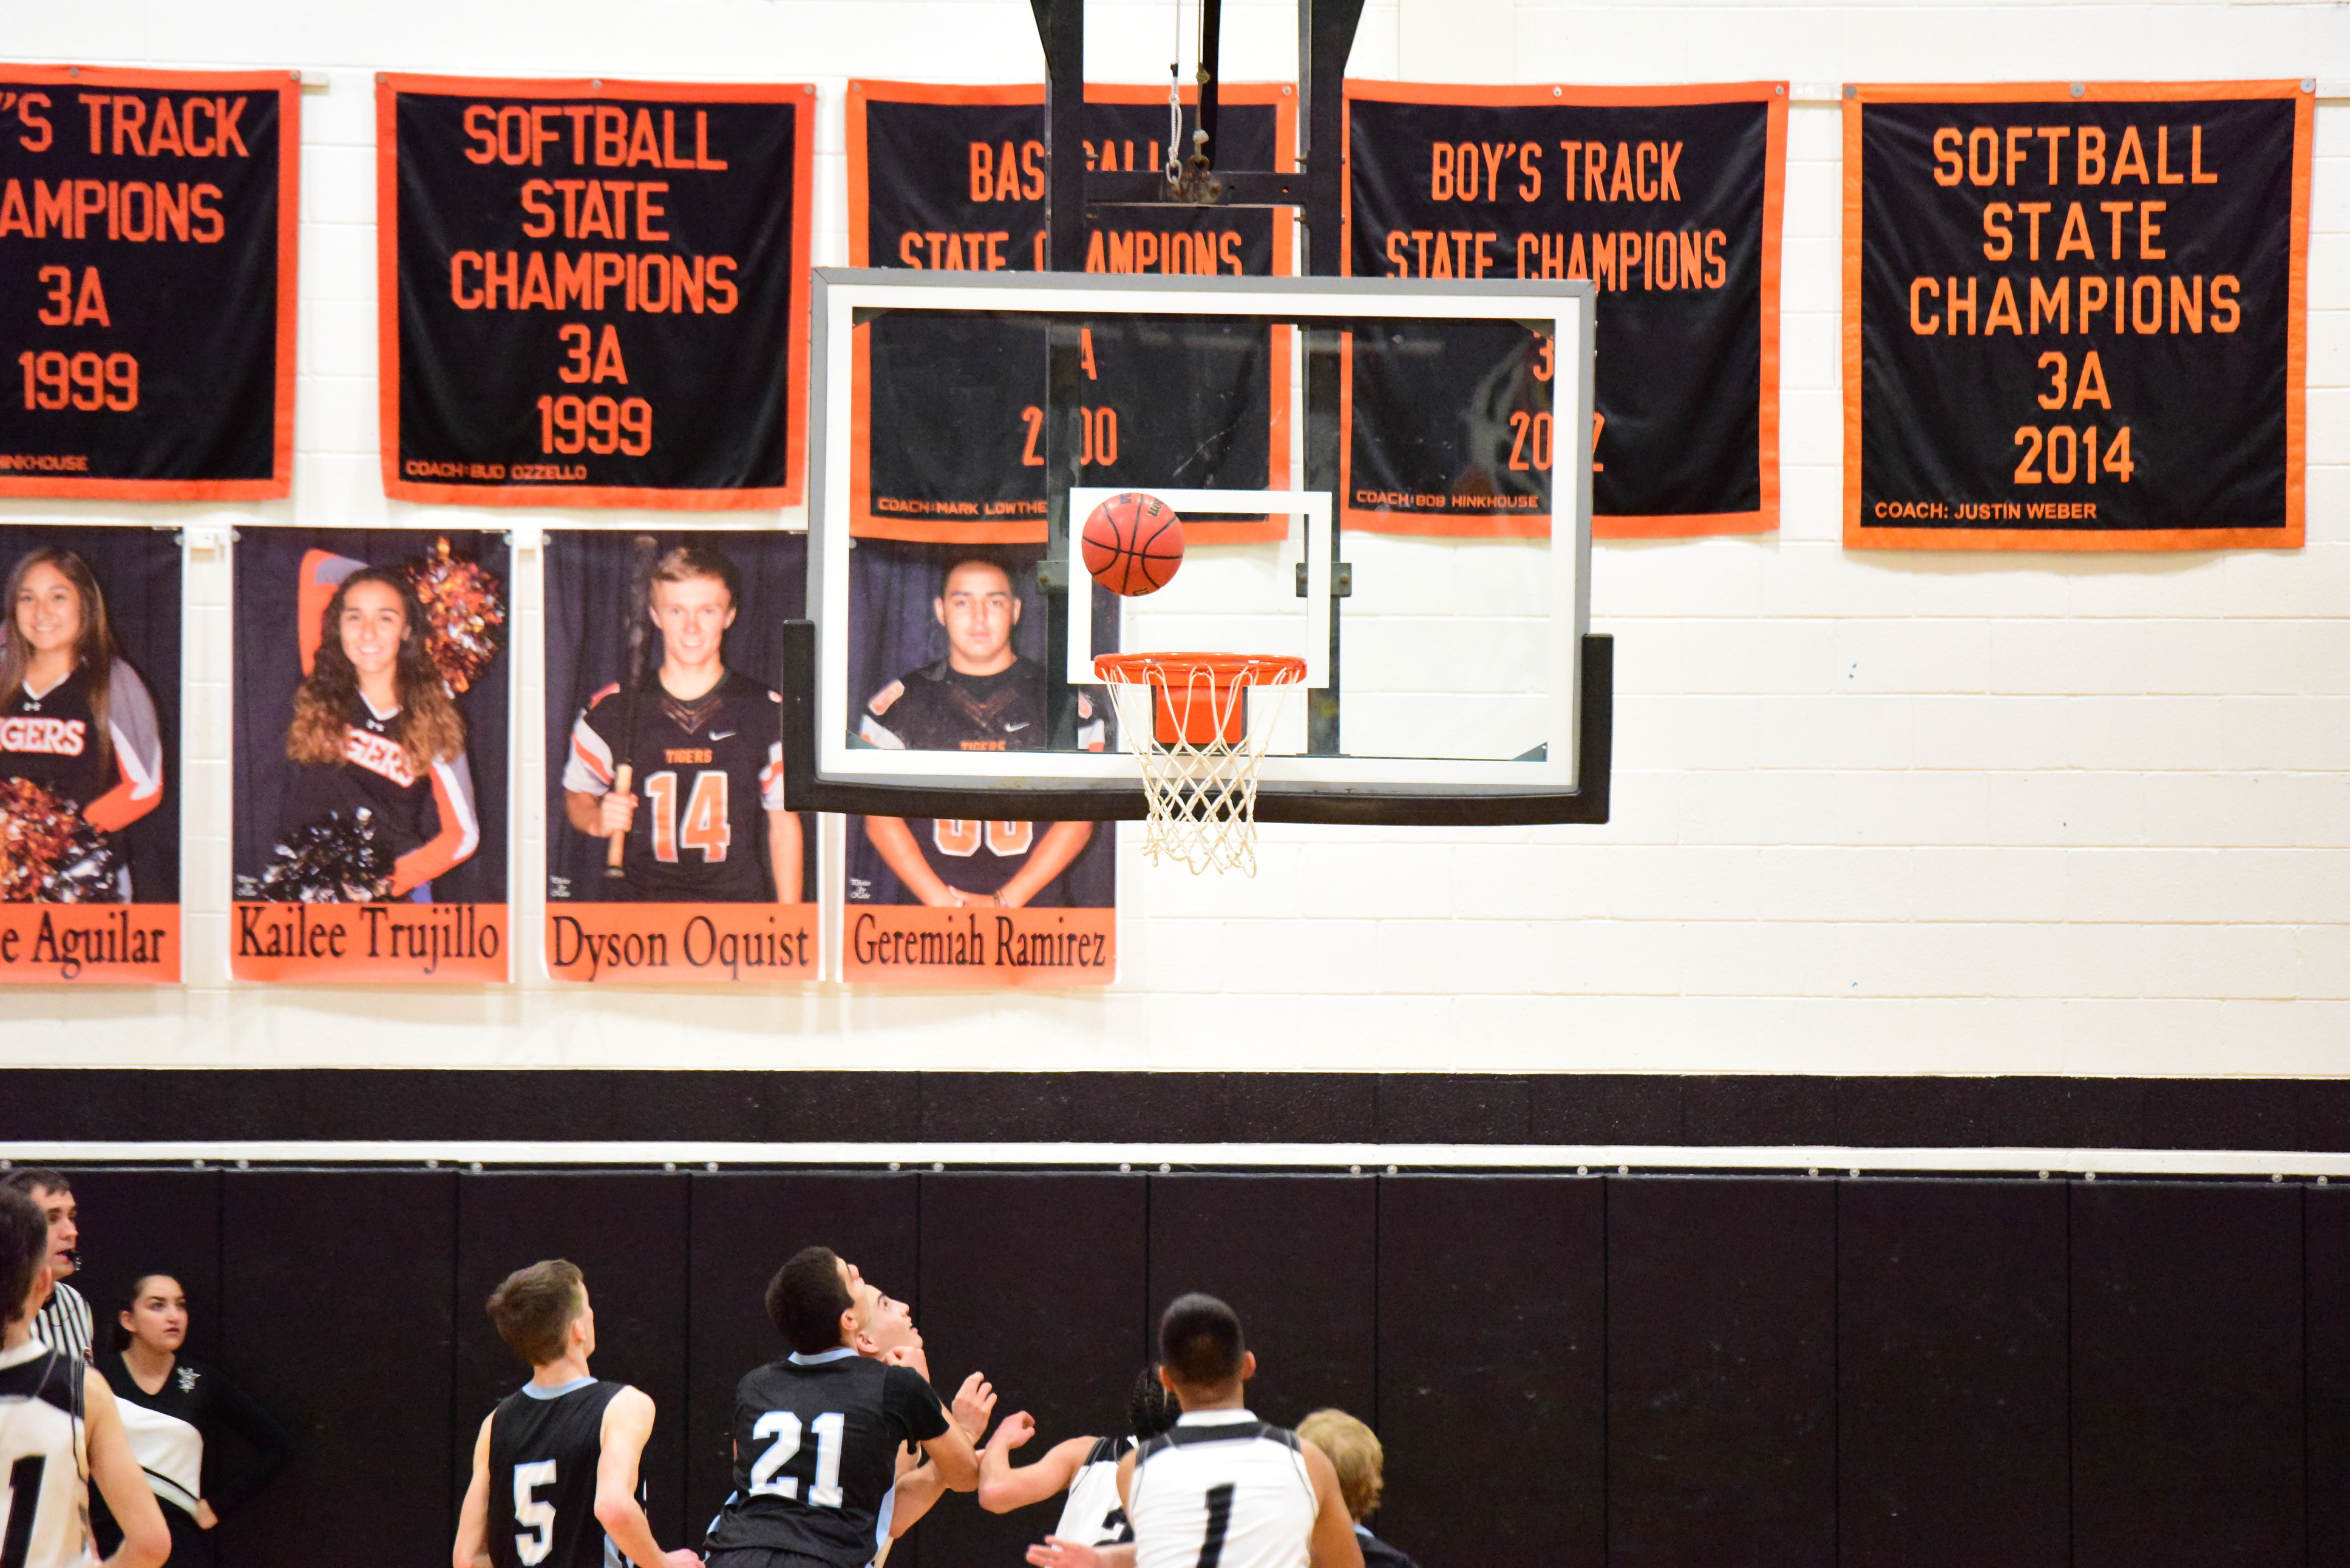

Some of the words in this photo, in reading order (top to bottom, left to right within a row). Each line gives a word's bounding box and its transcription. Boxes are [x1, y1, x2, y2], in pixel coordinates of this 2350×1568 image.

[0, 92, 53, 152] 'S
[79, 94, 249, 157] TRACK
[463, 104, 728, 171] SOFTBALL
[1431, 141, 1543, 202] BOY'S
[1560, 141, 1683, 202] TRACK
[1933, 125, 2218, 186] SOFTBALL
[521, 178, 670, 241] STATE
[1983, 200, 2167, 261] STATE
[450, 250, 739, 314] CHAMPIONS
[1033, 230, 1243, 275] AMPIONS
[1386, 230, 1497, 278] STATE
[1516, 228, 1727, 292] CHAMPIONS
[38, 265, 110, 327] 3A
[1910, 274, 2241, 336] CHAMPIONS
[19, 351, 138, 411] 1999
[559, 324, 628, 384] 3A
[2037, 350, 2112, 410] 3A
[537, 395, 652, 456] 1999
[1021, 406, 1118, 466] 200
[1509, 410, 1606, 472] 202
[2014, 425, 2134, 484] 2014
[983, 499, 1048, 515] LOWTHE
[1452, 494, 1539, 509] HINKHOUSE
[1875, 502, 1948, 519] COACH:
[1954, 503, 2021, 520] JUSTIN
[2026, 503, 2097, 520] WEBER
[0, 717, 86, 756] GERS
[665, 748, 713, 764] TIGERS
[644, 770, 731, 863] 14
[30, 910, 167, 980] Aguilar
[237, 906, 347, 959] Kailee
[360, 906, 500, 975] Trujillo
[552, 915, 669, 982] Dyson
[683, 915, 809, 981] Oquist
[853, 912, 985, 966] Geremiah
[994, 915, 1106, 967] Ramirez
[749, 1410, 845, 1508] 21
[513, 1458, 557, 1566] 5
[1196, 1482, 1237, 1568] 1
